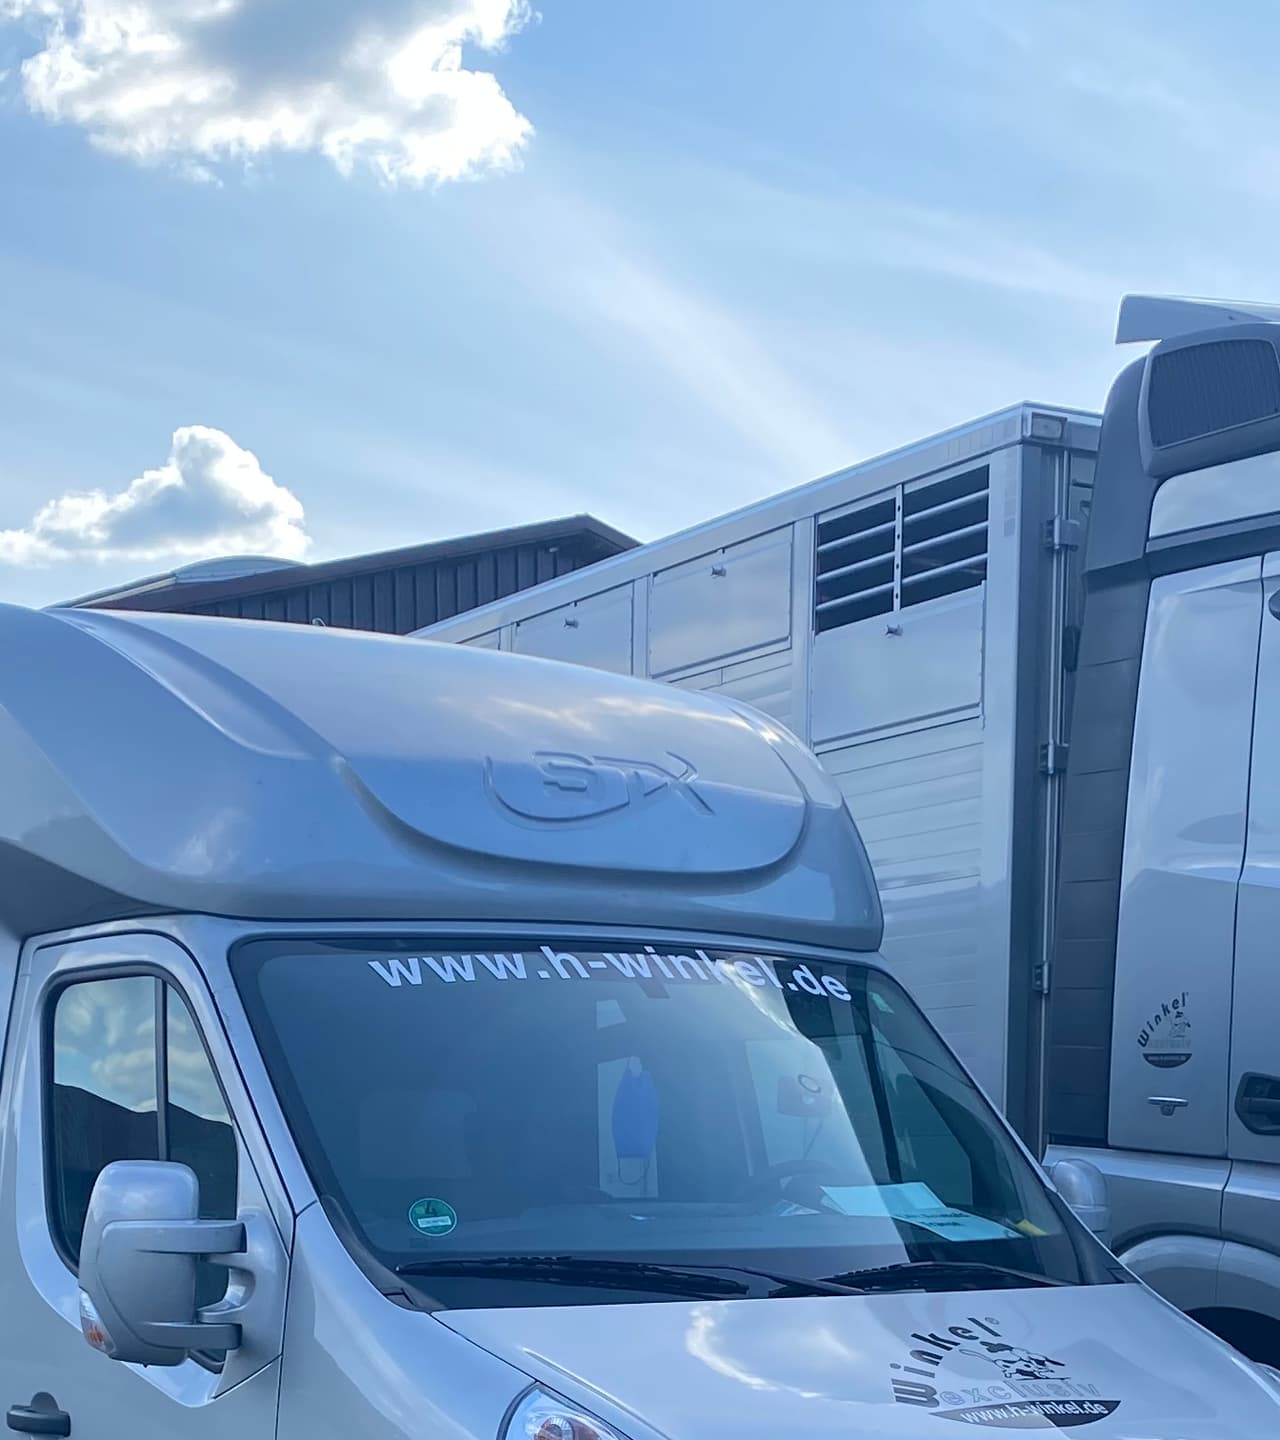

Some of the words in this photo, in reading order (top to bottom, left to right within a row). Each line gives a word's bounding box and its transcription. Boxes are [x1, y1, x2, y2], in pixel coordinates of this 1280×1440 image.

[368, 945, 852, 1001] www.h-winkel.de
[939, 1381, 1103, 1406] exclusiv
[961, 1400, 1107, 1424] www.h-winkel.de
